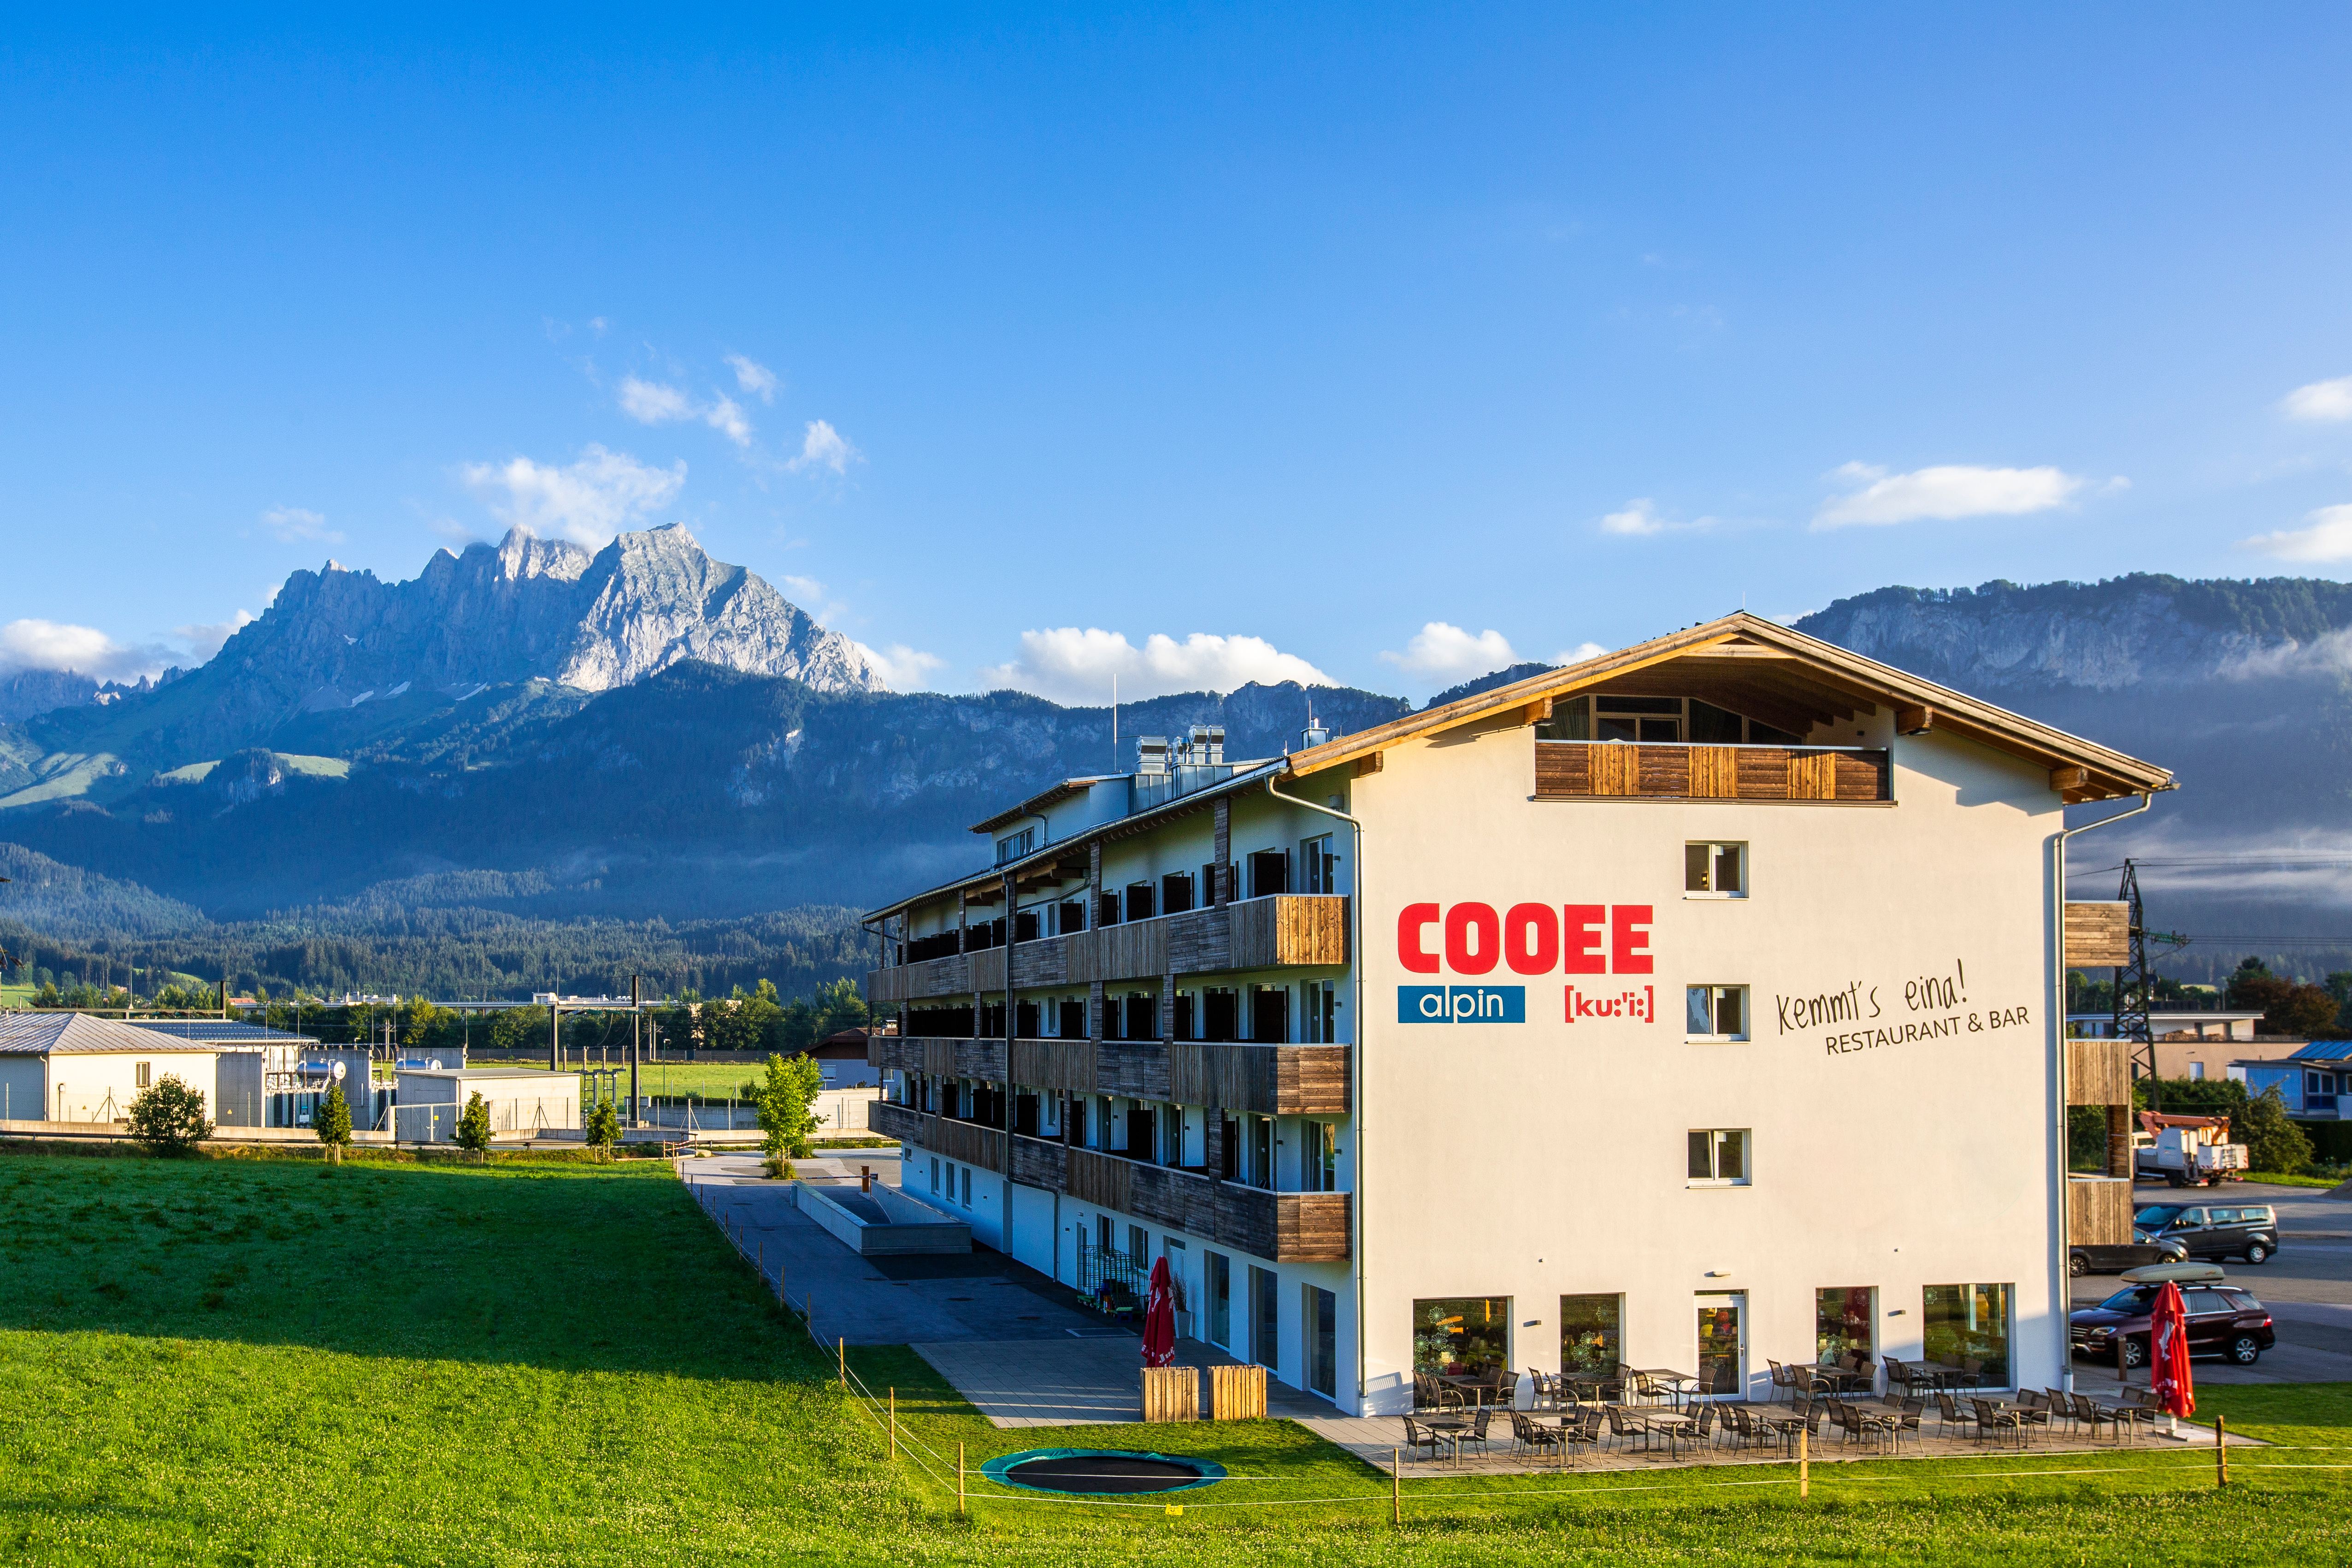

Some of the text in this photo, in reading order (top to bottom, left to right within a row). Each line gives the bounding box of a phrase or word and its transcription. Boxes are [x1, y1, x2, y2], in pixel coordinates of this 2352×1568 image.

[1398, 902, 1653, 975] COOEE
[1419, 985, 1504, 1023] alpin
[1905, 958, 1967, 1011] eina!
[1826, 1007, 2030, 1055] RESTAURANT & BAR
